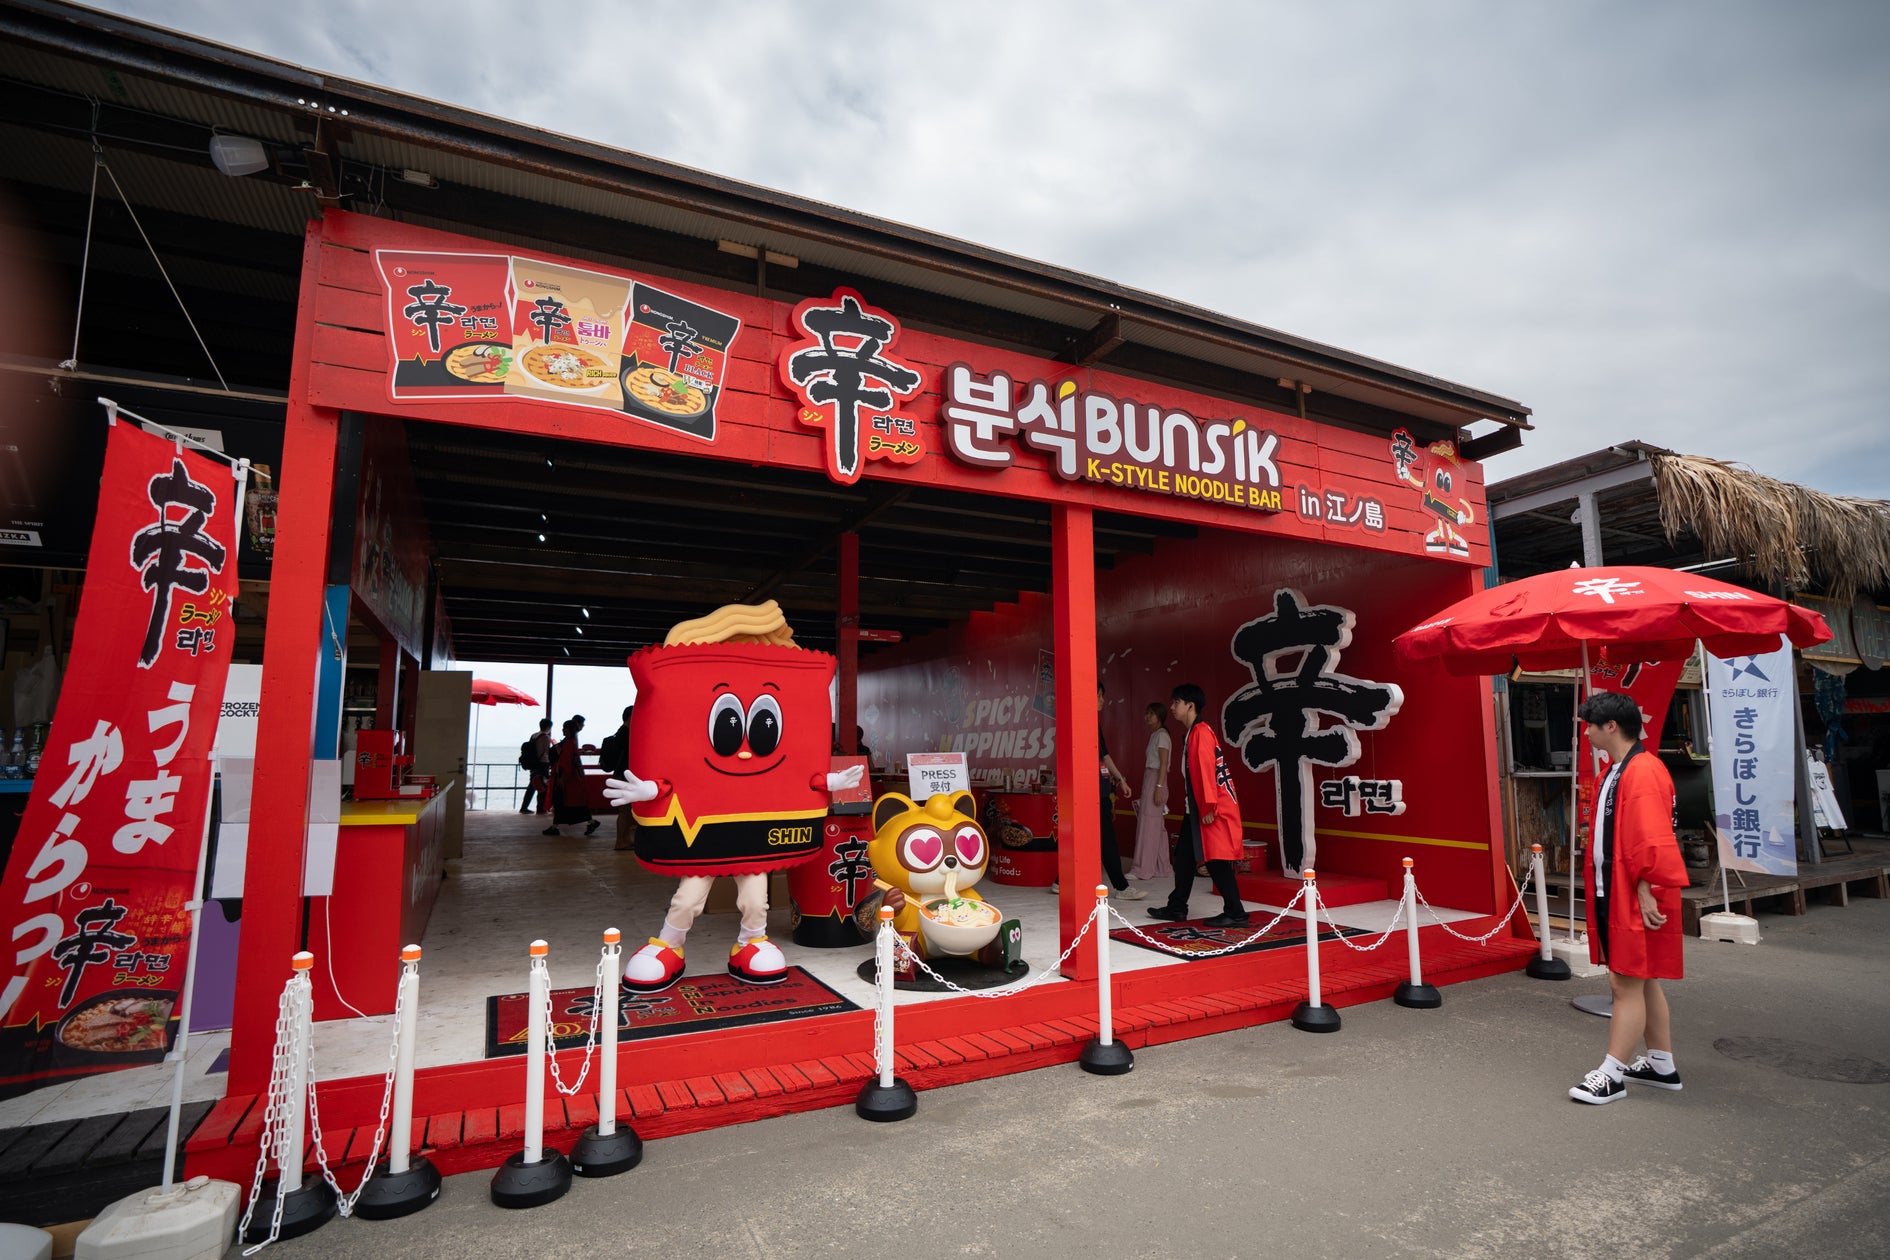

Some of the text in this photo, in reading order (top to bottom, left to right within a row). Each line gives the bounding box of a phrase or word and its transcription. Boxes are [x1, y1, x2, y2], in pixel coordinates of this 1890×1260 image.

[403, 279, 468, 353] 辛
[460, 316, 498, 330] 라면
[529, 296, 572, 345] 辛
[463, 330, 498, 340] ラーメン
[658, 320, 704, 375] 辛
[586, 368, 603, 379] RICH
[684, 363, 715, 380] BLACK
[788, 295, 922, 476] 辛
[803, 409, 825, 422] シン
[872, 415, 916, 436] 라면
[948, 366, 1077, 476] 분식
[869, 435, 920, 456] ラーメン
[1086, 457, 1283, 511] K-STYLE NOODLE BAR
[1326, 492, 1384, 530] 江ノ島
[130, 457, 226, 669] 辛
[209, 587, 227, 605] シン
[179, 604, 222, 625] ラーメン
[1721, 688, 1778, 698] きらぼし銀行
[962, 694, 1029, 729] SPICY
[938, 727, 1057, 759] HAPPINESS
[1221, 587, 1405, 880] 辛
[921, 768, 957, 780] PRESS
[1732, 706, 1762, 859] きらぼし銀行
[930, 781, 951, 792] 受付
[1320, 775, 1407, 817] 라면
[767, 826, 813, 846] SHIN
[830, 884, 844, 893] シン
[52, 897, 137, 1009] 辛
[113, 950, 171, 973] 라면
[45, 976, 63, 988] シン
[112, 971, 164, 986] ラーメン
[683, 982, 804, 1000] Happiness
[694, 997, 798, 1016] Noodles
[818, 1004, 843, 1012] 1986
